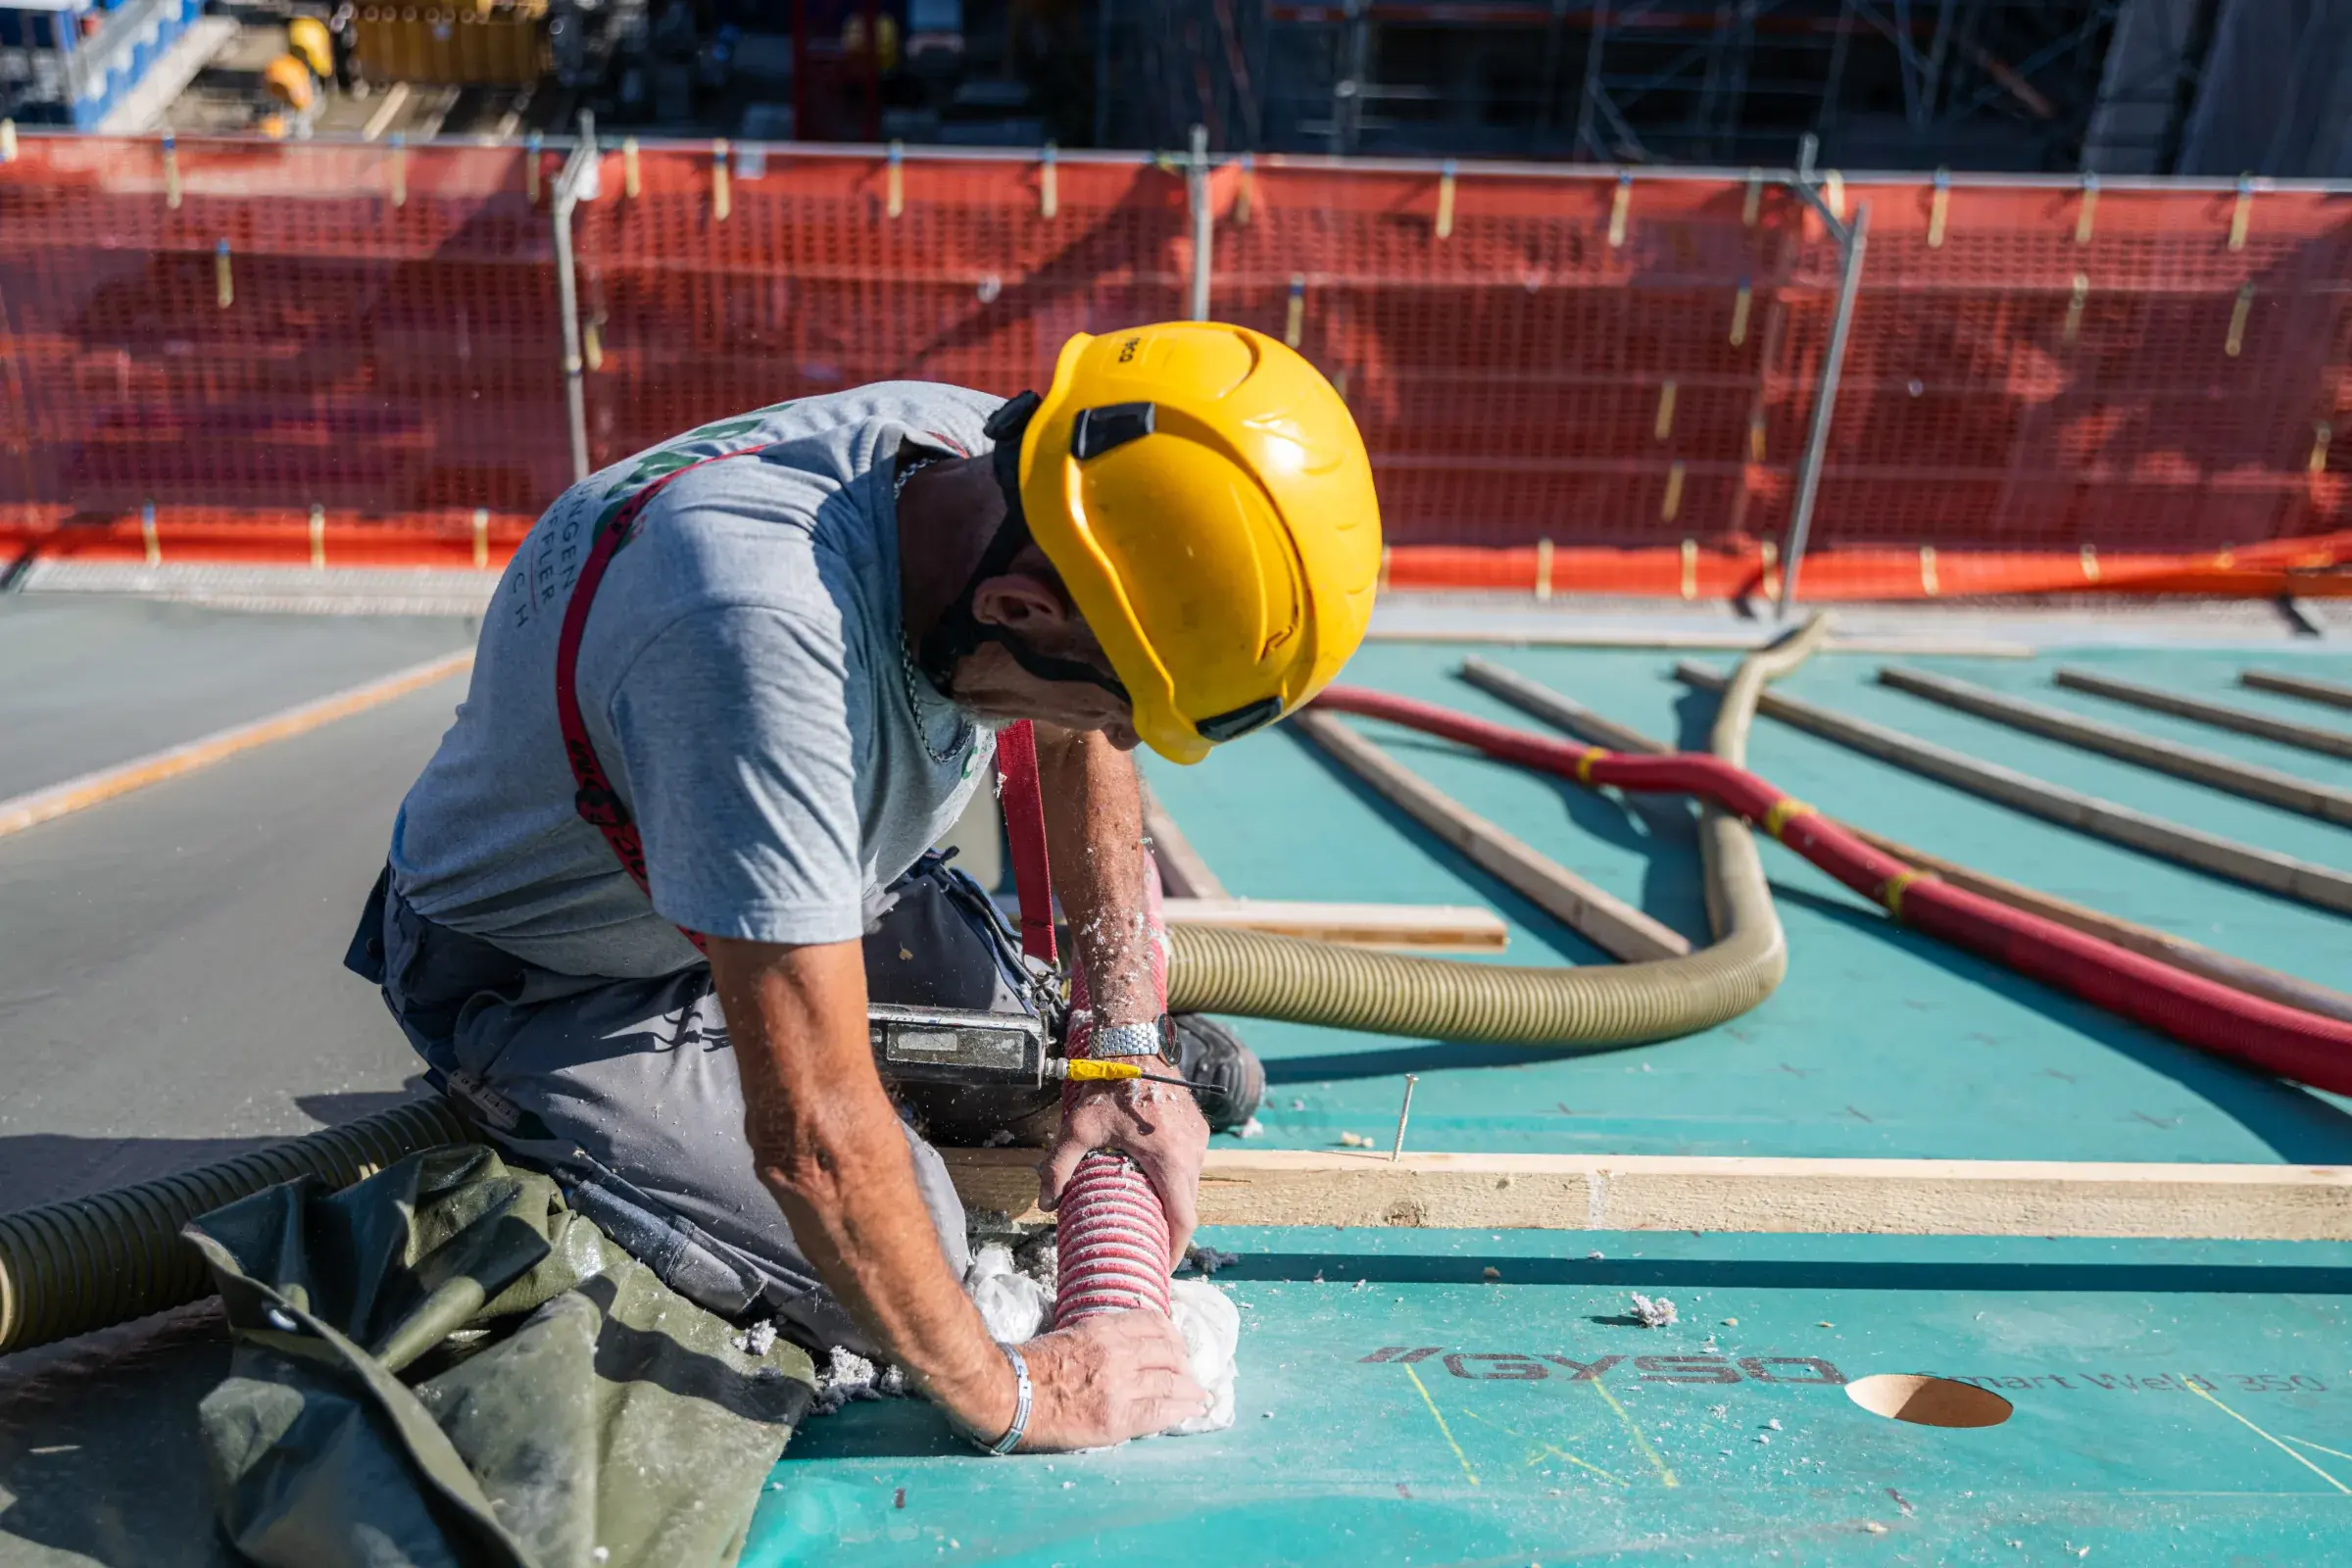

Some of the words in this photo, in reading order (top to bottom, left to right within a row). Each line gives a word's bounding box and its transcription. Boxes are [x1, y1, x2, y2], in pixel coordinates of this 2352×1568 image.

[1443, 1351, 1849, 1385] GYSO
[2078, 1371, 2220, 1393] Weld
[2227, 1372, 2329, 1394] 350
